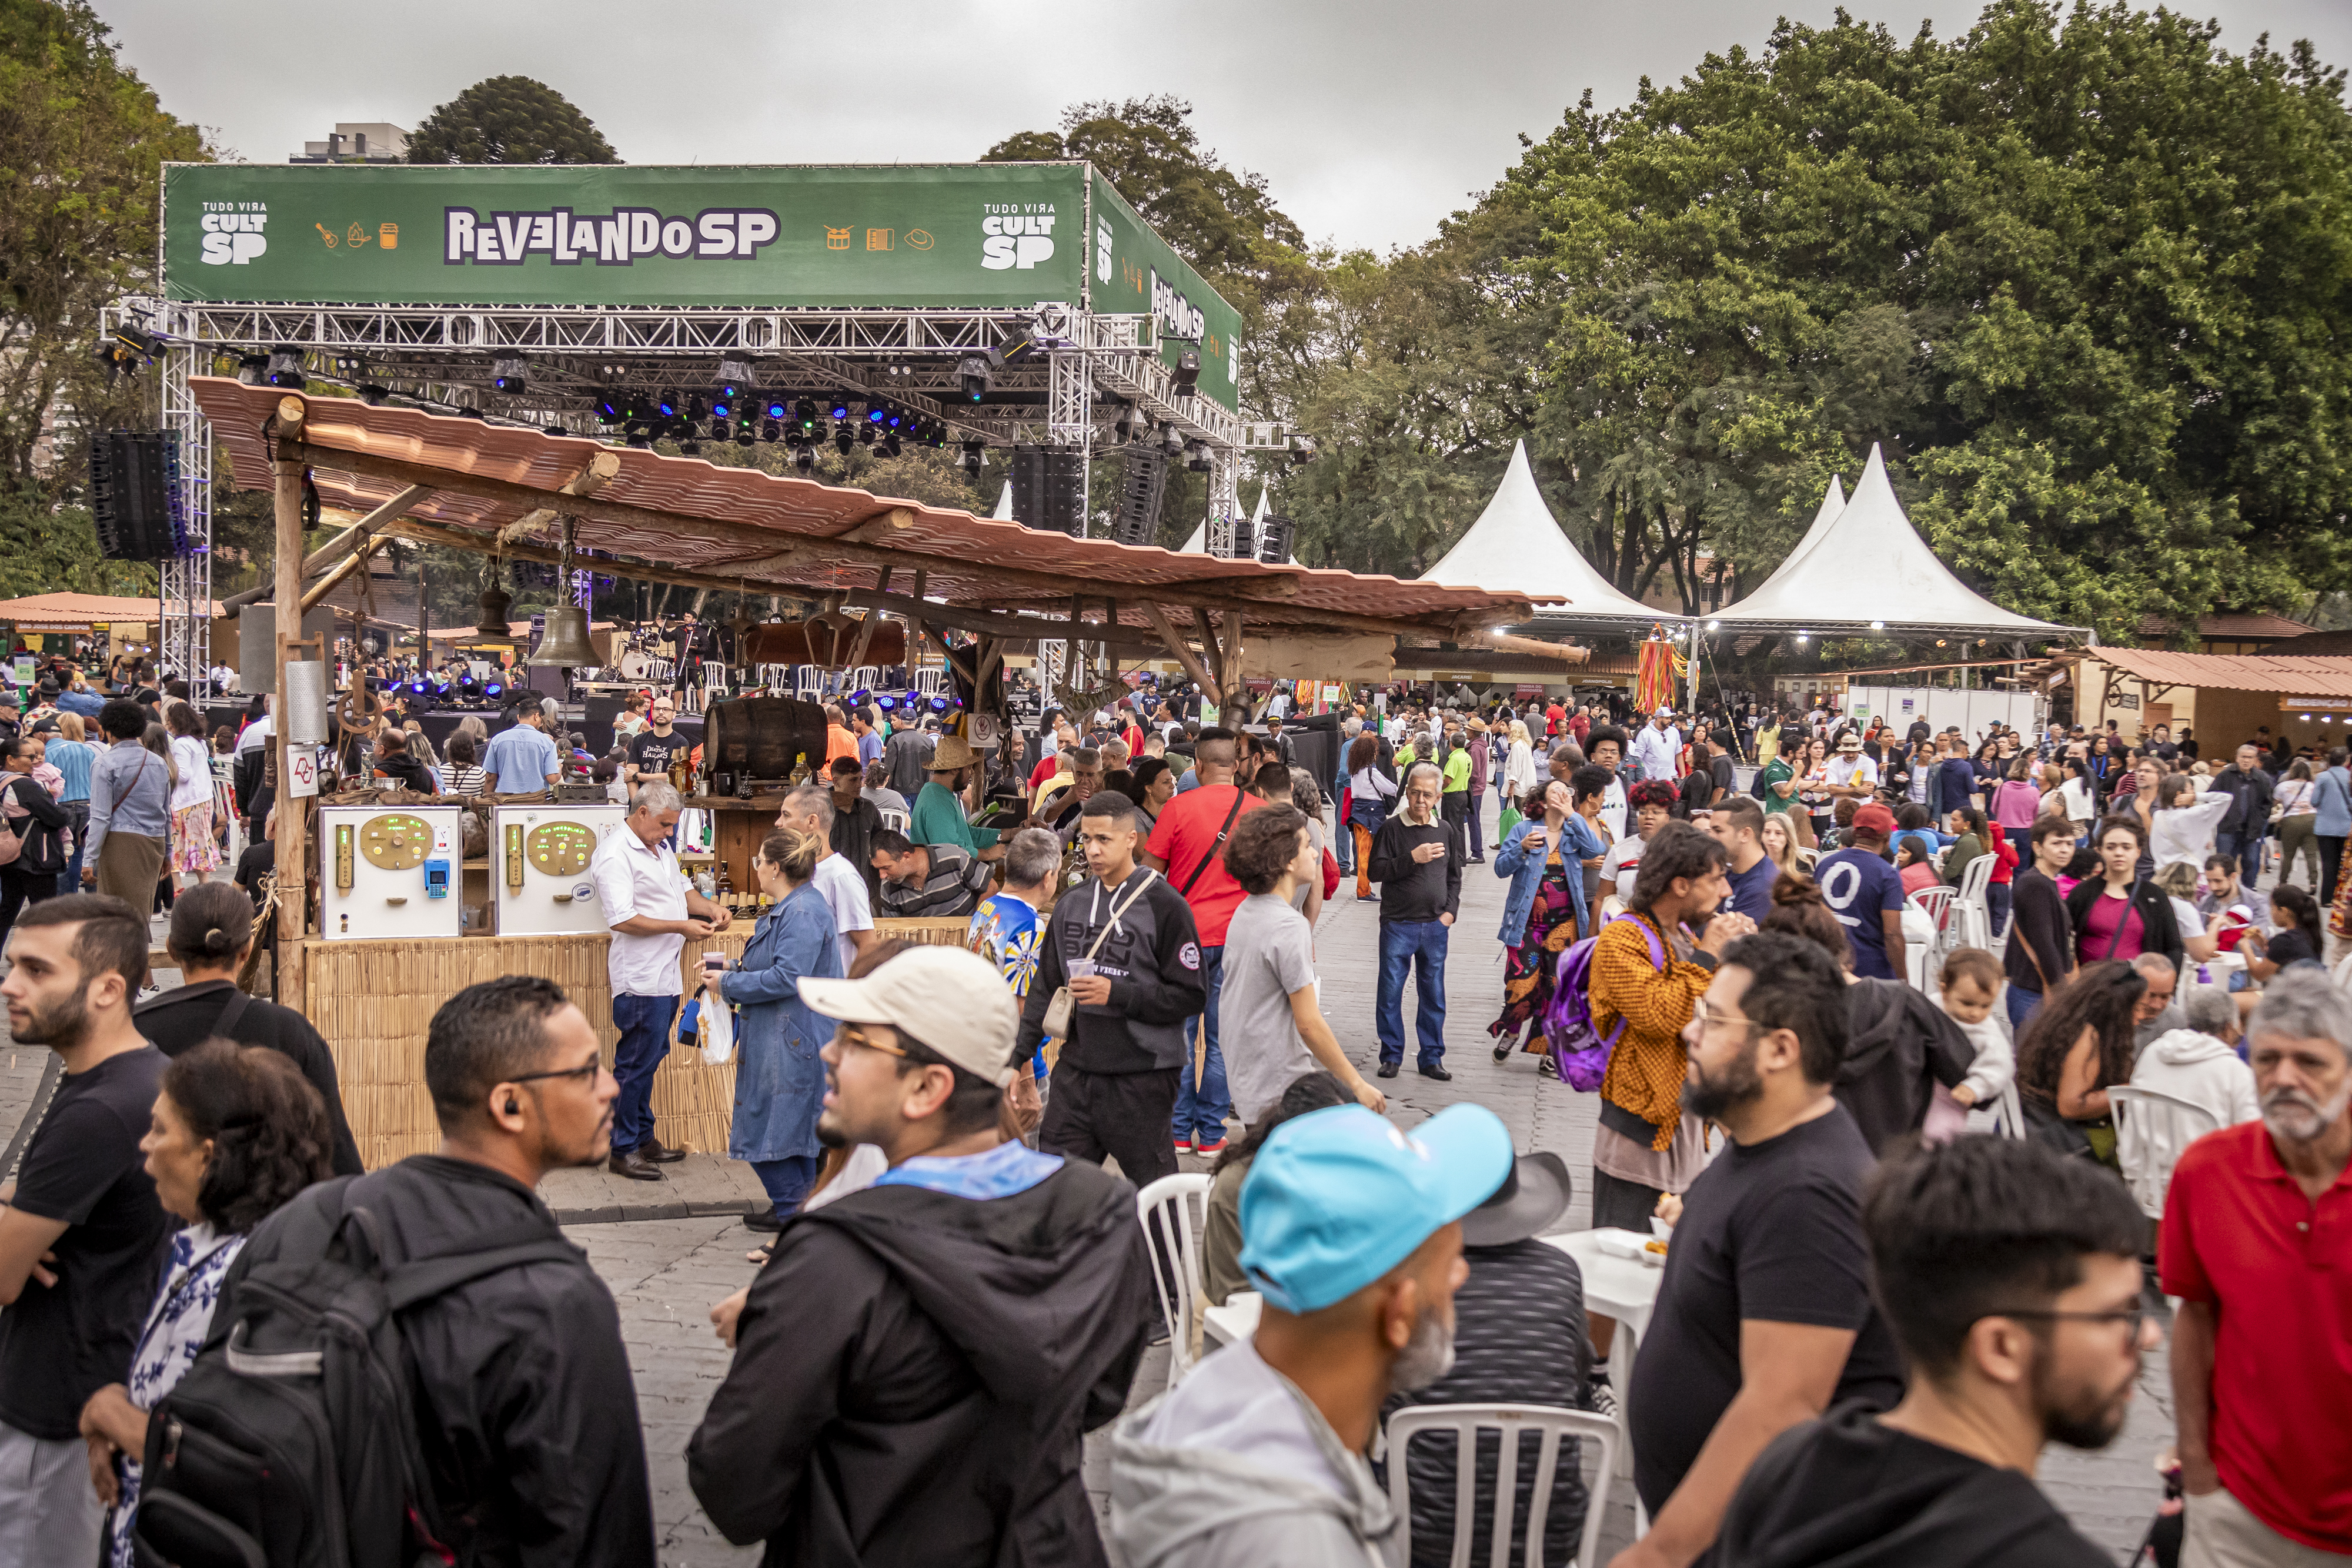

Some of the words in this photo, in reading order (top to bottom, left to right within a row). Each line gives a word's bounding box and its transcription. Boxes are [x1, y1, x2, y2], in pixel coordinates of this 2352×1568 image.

[202, 202, 234, 212] TUDO
[238, 202, 268, 212] VIRA
[984, 203, 1018, 214] TUDO
[1024, 203, 1055, 213] VIRA
[201, 213, 268, 233] CULT
[982, 215, 1055, 236] CULT
[200, 232, 268, 265] SP
[980, 235, 1055, 270] SP
[1097, 226, 1112, 256] CULT
[1097, 246, 1112, 286] SP
[1228, 357, 1237, 385] SP
